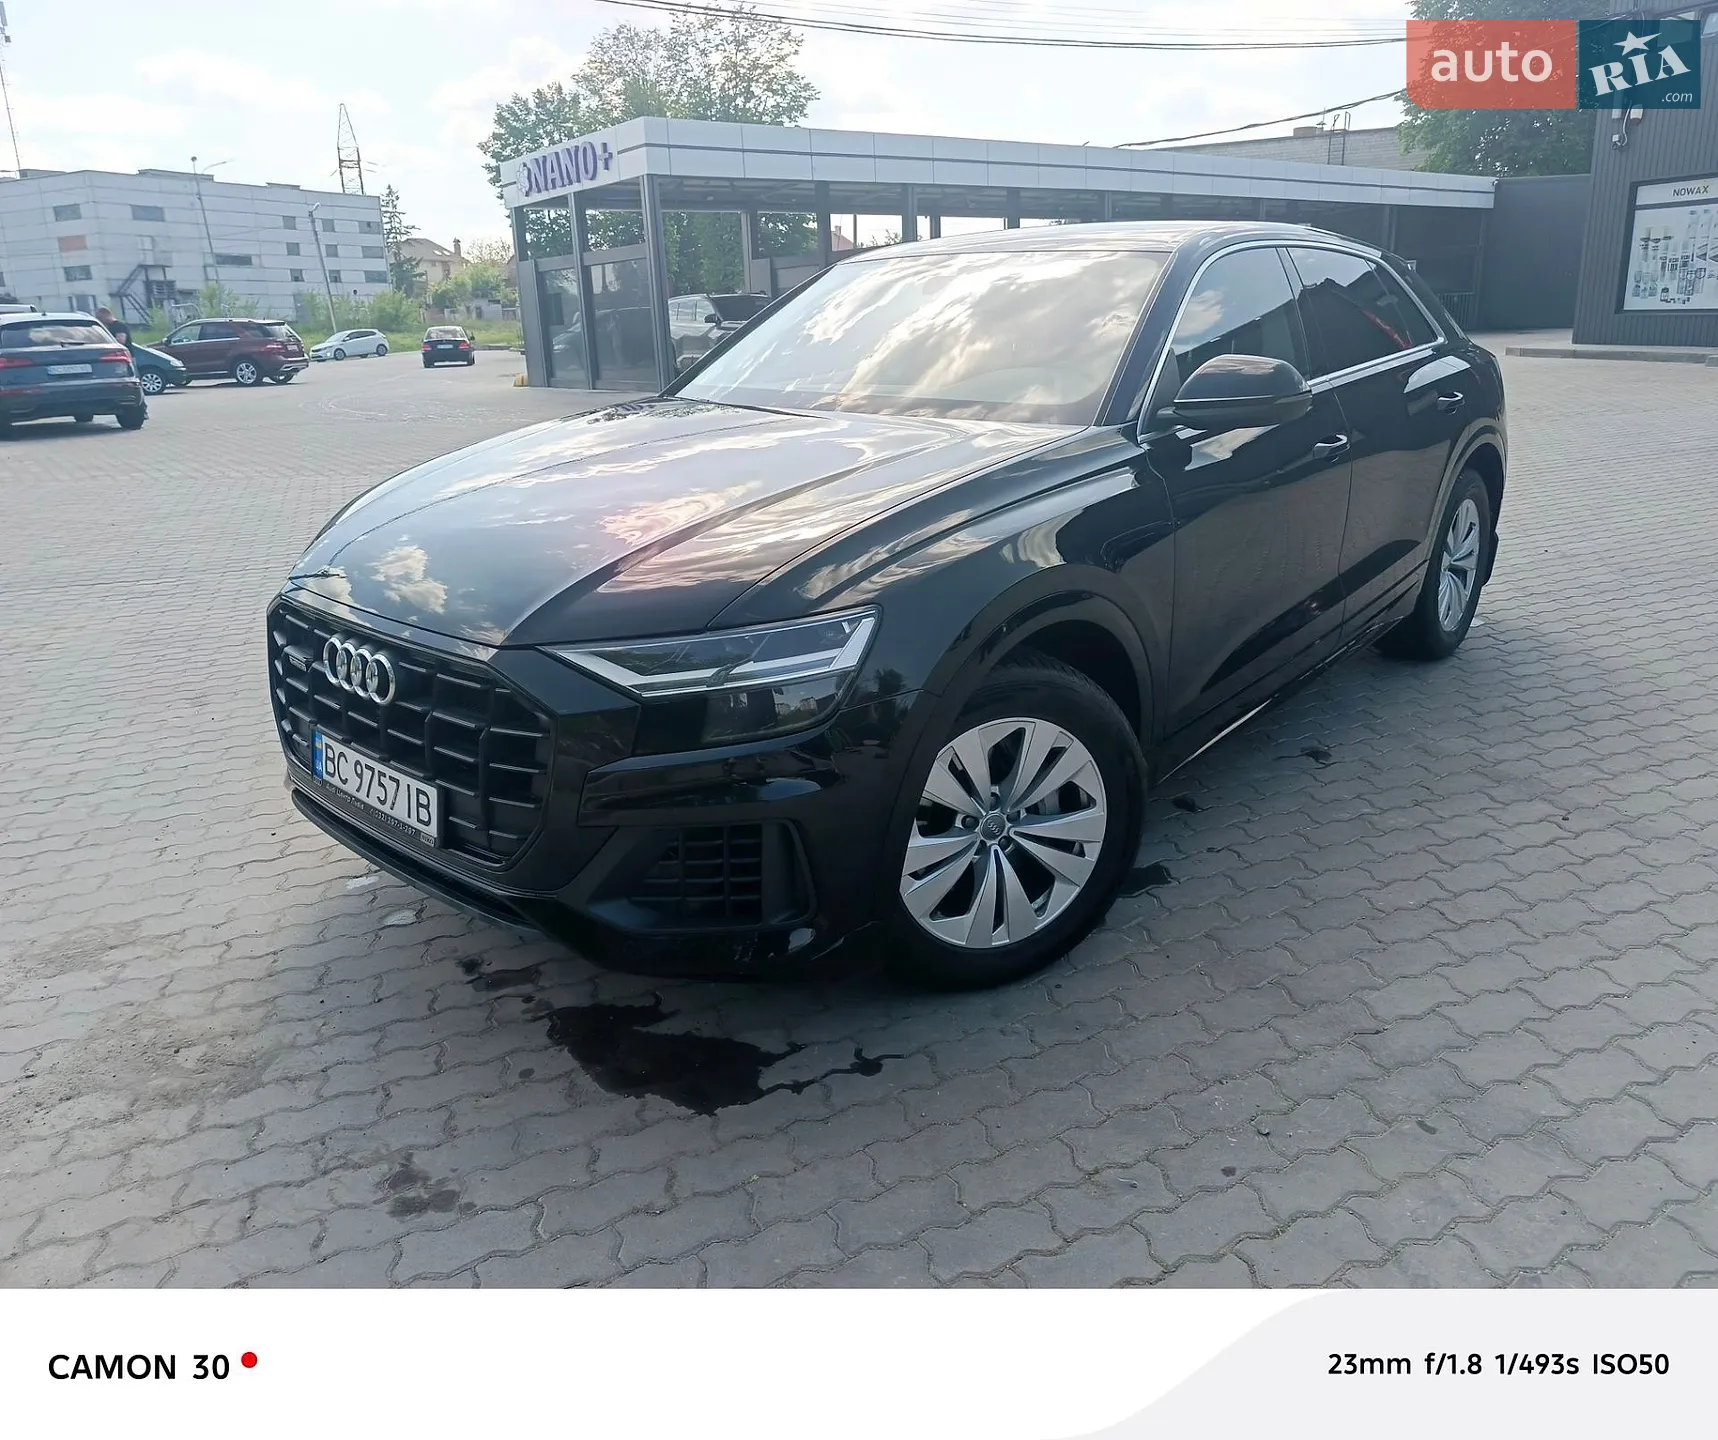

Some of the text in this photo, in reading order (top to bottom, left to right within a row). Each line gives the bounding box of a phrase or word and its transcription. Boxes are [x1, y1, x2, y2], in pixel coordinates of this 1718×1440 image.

[1672, 185, 1709, 197] NOWAX
[325, 742, 432, 827] BC 9757 IB
